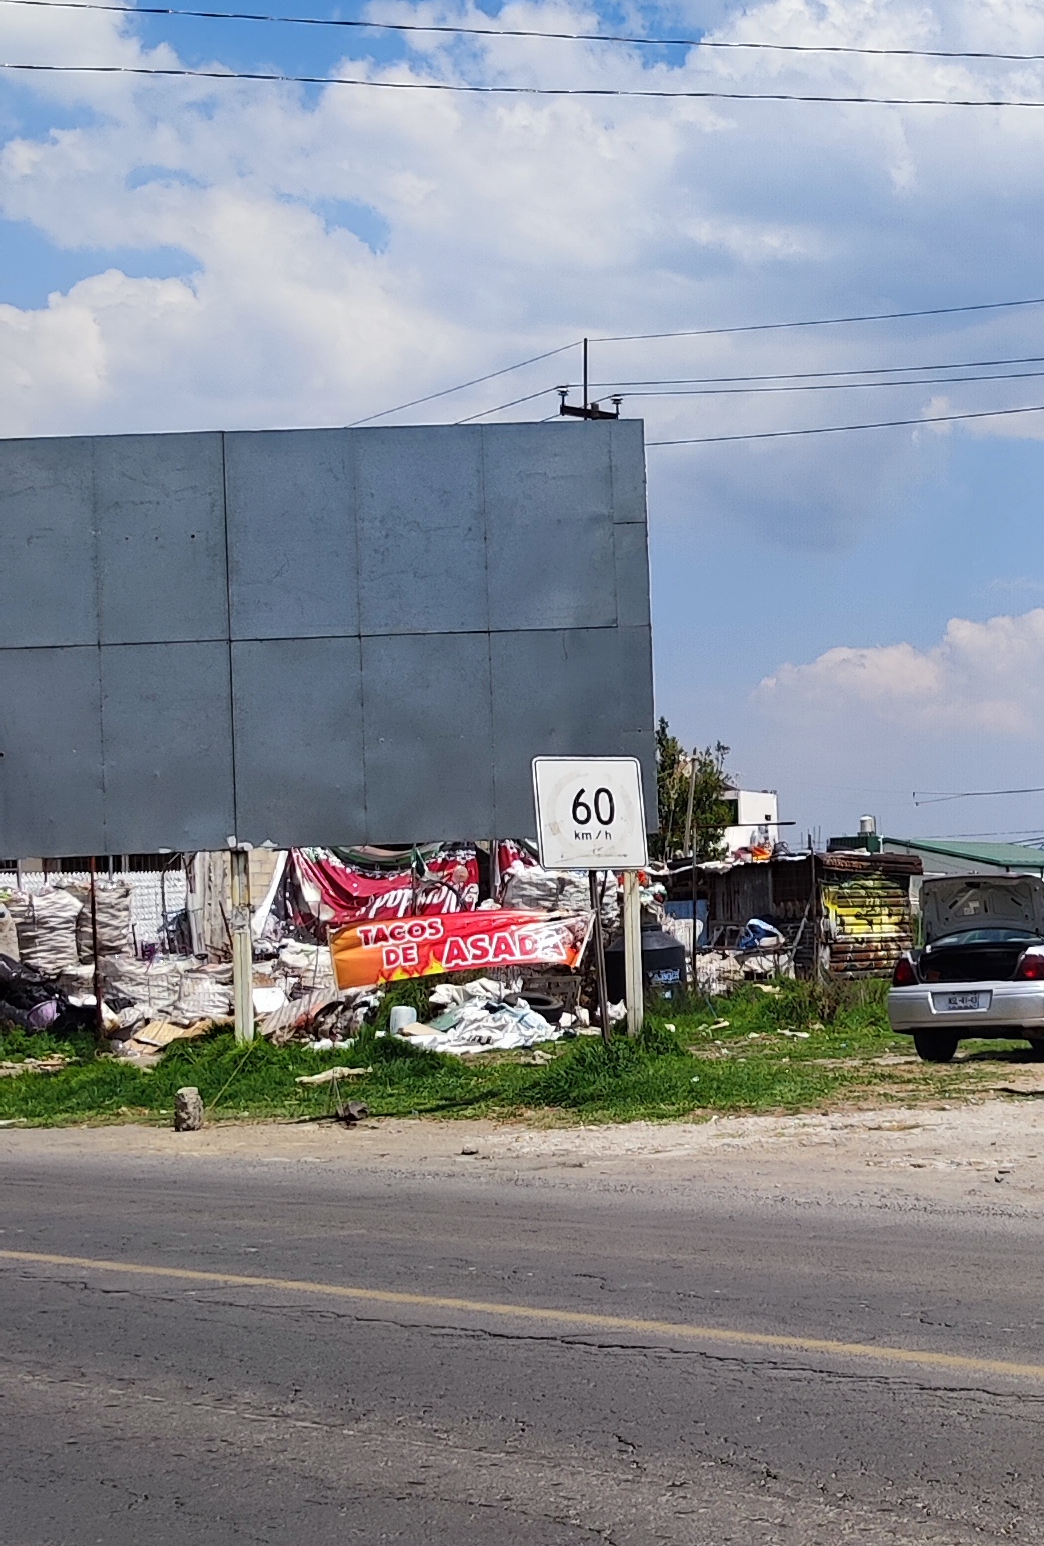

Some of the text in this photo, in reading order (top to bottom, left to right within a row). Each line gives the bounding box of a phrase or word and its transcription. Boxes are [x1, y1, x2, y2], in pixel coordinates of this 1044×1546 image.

[571, 787, 615, 826] 60
[357, 918, 444, 948] TACOS
[383, 944, 419, 969] DE
